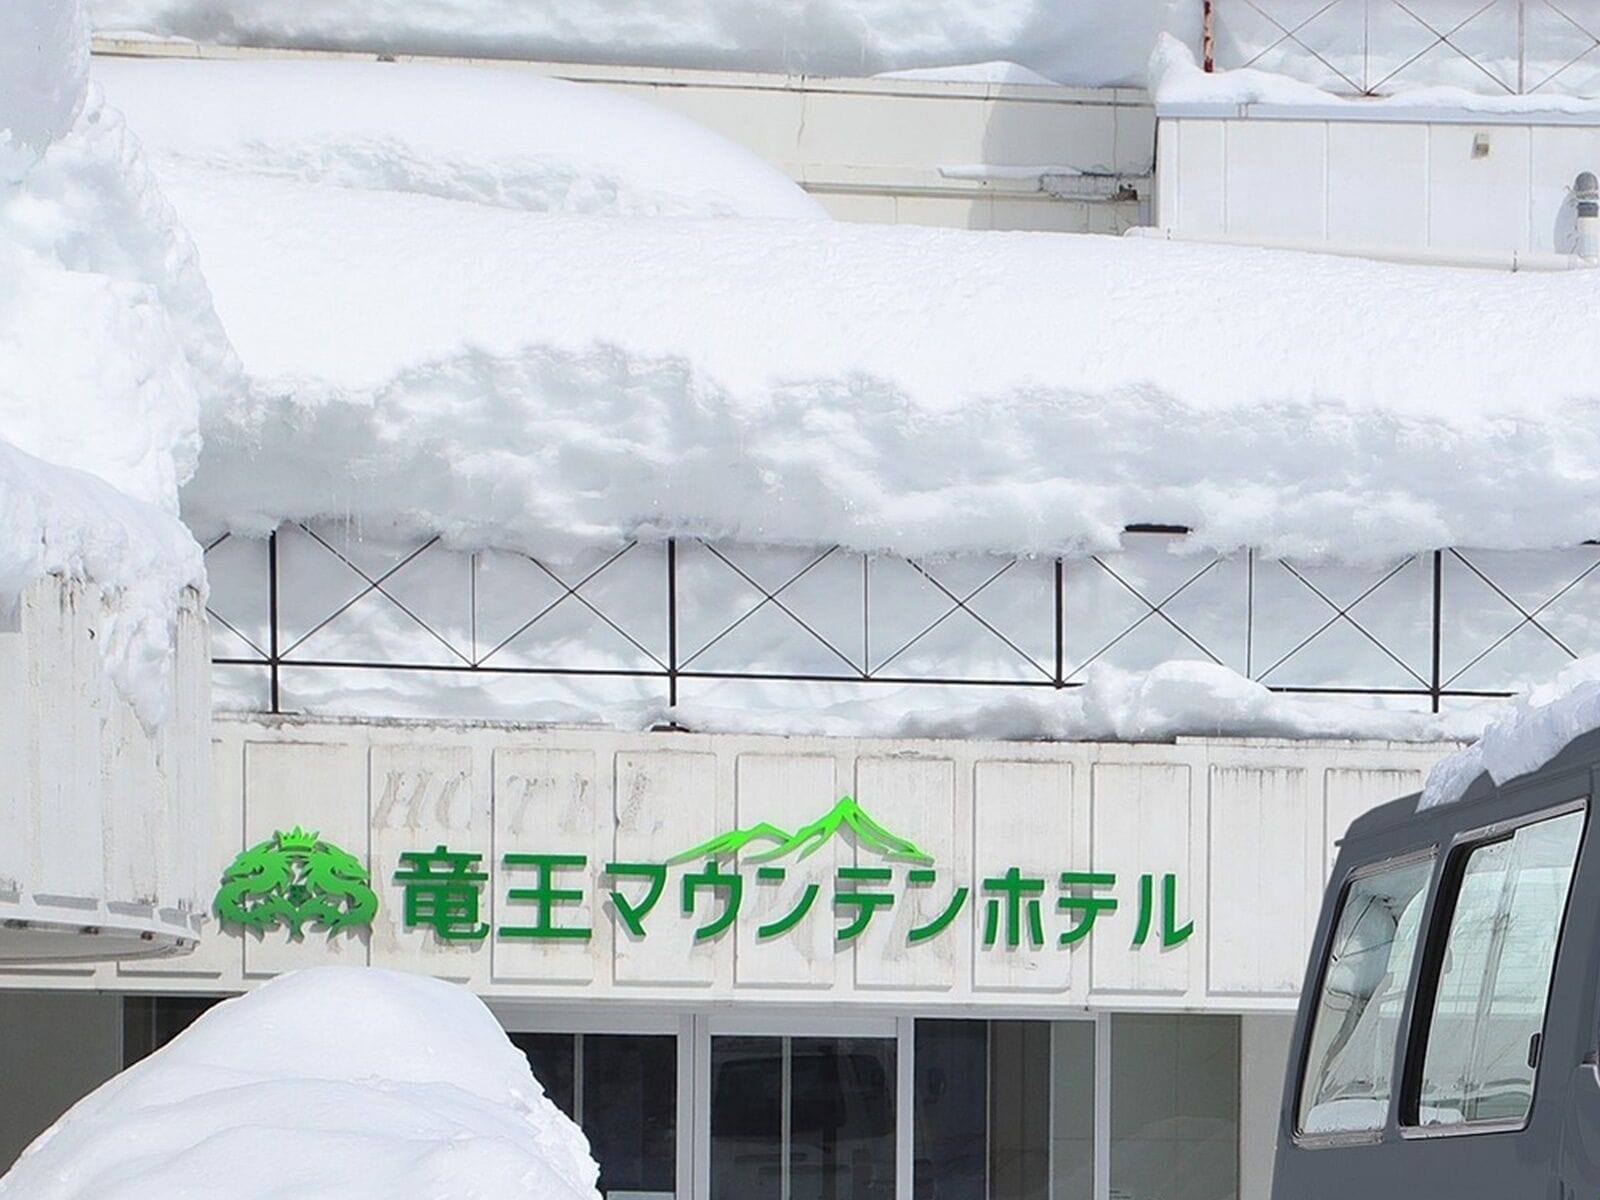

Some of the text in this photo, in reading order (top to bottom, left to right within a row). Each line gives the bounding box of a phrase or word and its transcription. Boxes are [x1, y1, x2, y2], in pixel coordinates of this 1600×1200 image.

[394, 846, 1194, 947] 竜王マウンテンホテル
